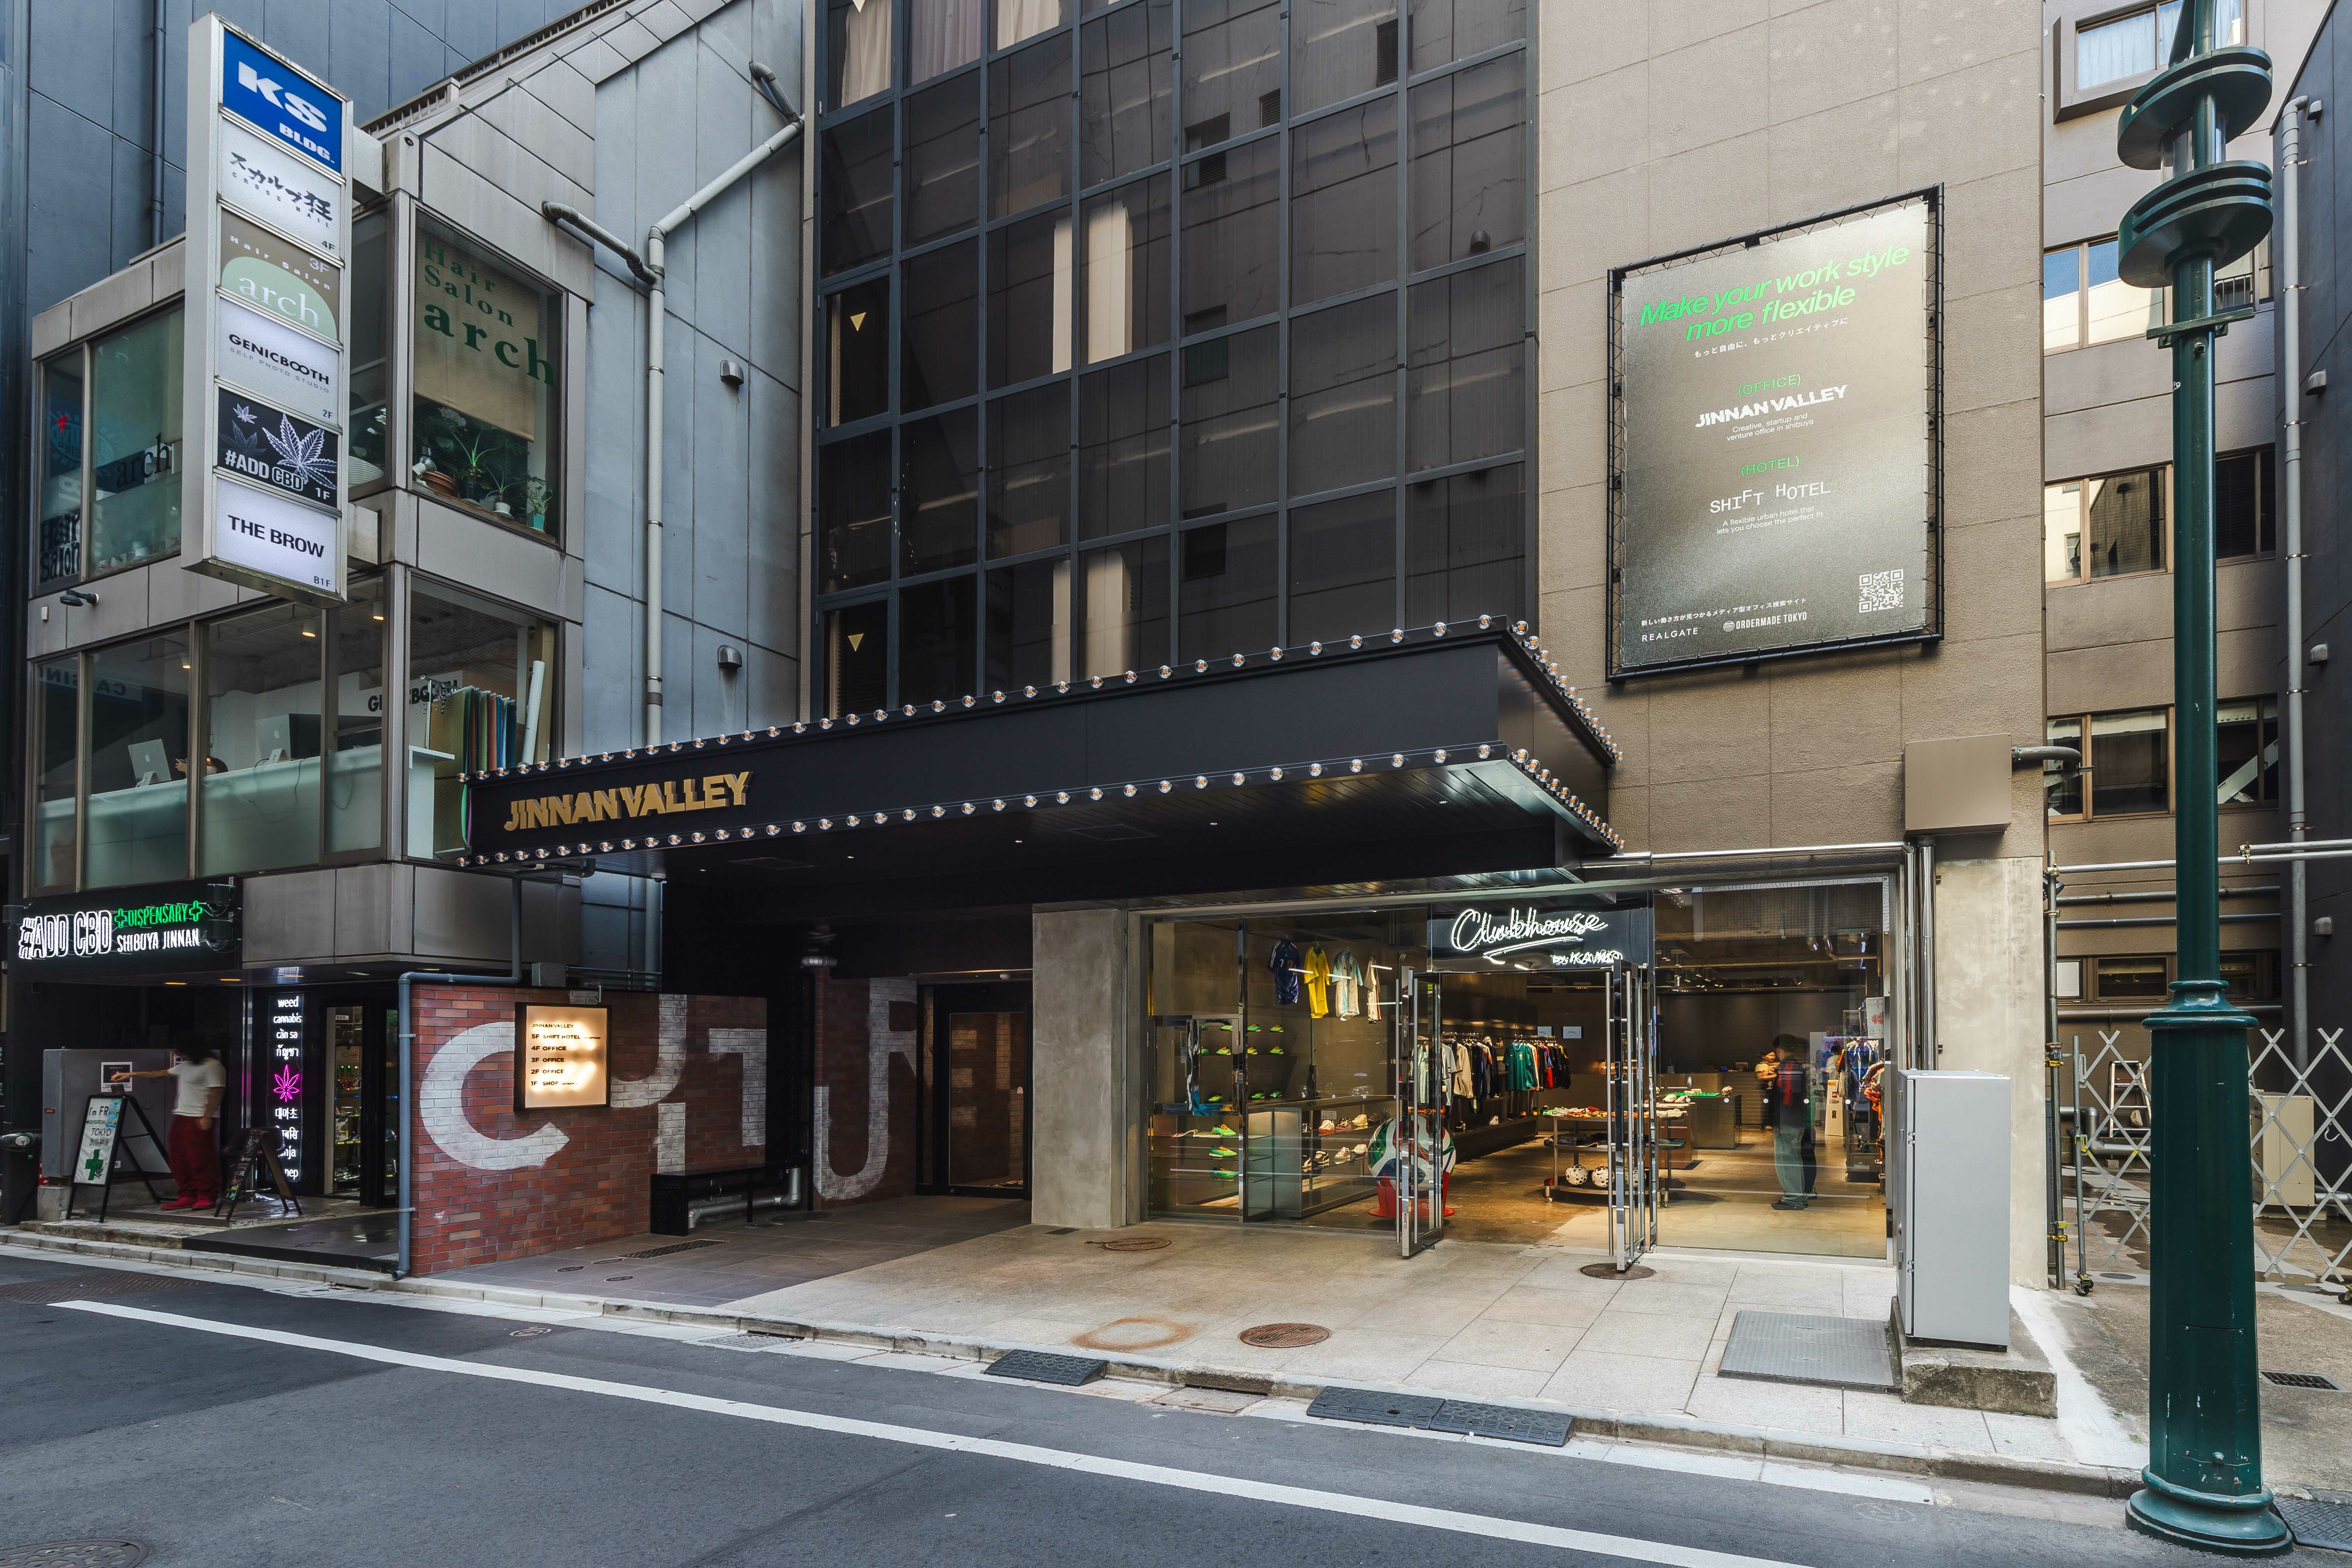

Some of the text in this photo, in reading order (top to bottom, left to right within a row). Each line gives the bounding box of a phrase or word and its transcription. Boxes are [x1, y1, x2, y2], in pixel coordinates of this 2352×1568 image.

[238, 61, 327, 132] KS
[279, 123, 335, 164] BLDG.
[230, 151, 333, 222] スカルプ狂
[232, 172, 330, 228] CROSS NAIL
[230, 235, 269, 259] Hair
[322, 241, 335, 250] 4F
[309, 257, 330, 273] 3F
[425, 239, 495, 293] Hair
[425, 265, 514, 327] Salon
[1639, 244, 1909, 327] Make your work style
[238, 277, 320, 328] arch
[1686, 286, 1856, 341] more flexible
[424, 305, 555, 387] arch
[229, 333, 330, 385] GENICBOOTH
[230, 347, 330, 393] SELF PHOTO STUDIO
[1738, 374, 1801, 398] (OFFICE)
[323, 409, 333, 419] 2F
[1733, 421, 1764, 433] Creative,
[1766, 416, 1791, 427] startup
[1727, 432, 1753, 441] venture
[1755, 427, 1774, 436] office
[1785, 419, 1814, 430] shibuya
[117, 433, 171, 488] arch
[225, 449, 303, 492] #ADD CBD
[1741, 456, 1800, 477] (HOTEL)
[315, 487, 331, 501] 1F
[1710, 481, 1831, 513] SHIFT HOTEL
[1730, 516, 1755, 526] flexible
[1757, 512, 1777, 521] urban
[1780, 508, 1798, 517] hotel
[1800, 505, 1814, 514] that
[1746, 521, 1772, 530] choose
[1788, 514, 1813, 524] perfect
[228, 514, 325, 558] THE BROW
[314, 576, 331, 588] B1F
[1736, 616, 1781, 630] ORDERMADE
[1783, 612, 1807, 623] TOKYO
[1642, 627, 1698, 642] REALGATE
[504, 772, 753, 831] JINNANVALLEY
[128, 904, 188, 927] DISPENSARY
[18, 910, 112, 960] #ADD CBD
[117, 928, 200, 953] SHIBUYA JINNAN
[1451, 907, 1609, 950] Clubhouse
[278, 996, 299, 1007] weed
[273, 1012, 302, 1023] cannabis
[275, 1107, 298, 1120] 대마초
[91, 1128, 112, 1136] TOKYO
